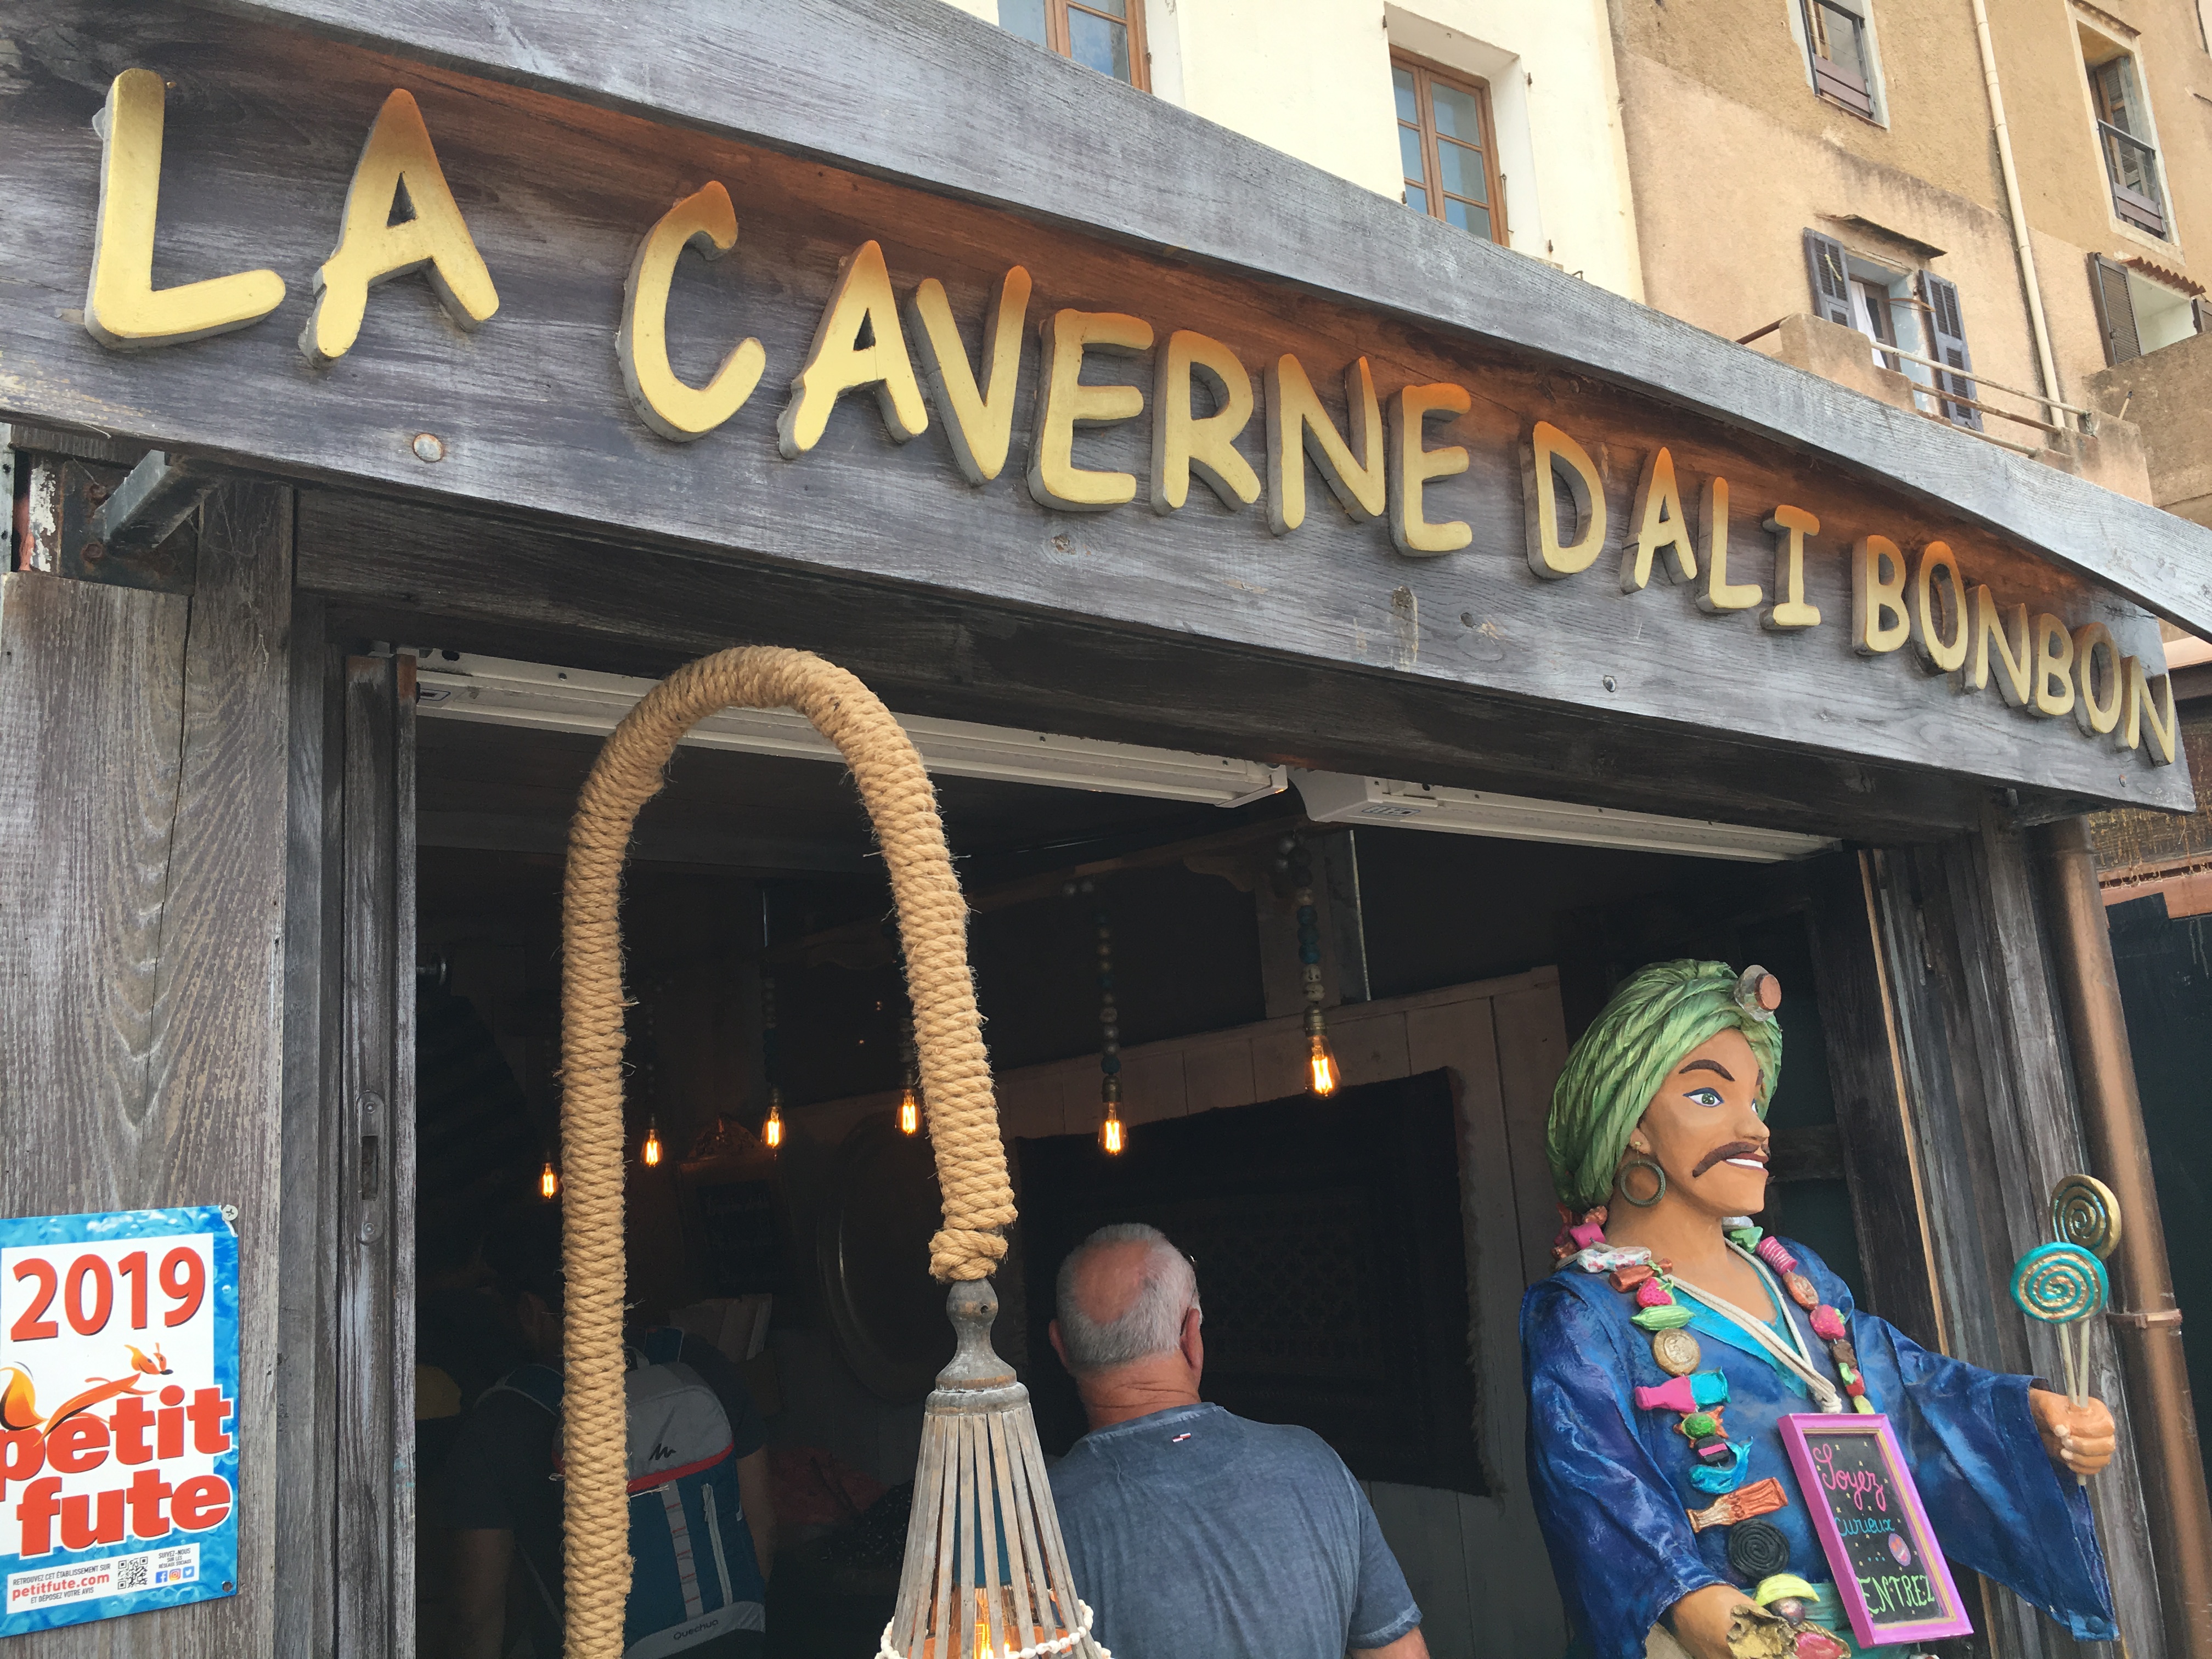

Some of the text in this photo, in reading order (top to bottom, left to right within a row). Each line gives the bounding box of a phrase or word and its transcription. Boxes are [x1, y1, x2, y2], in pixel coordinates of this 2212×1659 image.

[87, 68, 500, 366] LA
[619, 180, 1473, 555] CAVERNE
[1853, 534, 2176, 765] BONBON
[10, 1246, 206, 1342] 2019
[0, 1385, 231, 1502] petit
[1813, 1443, 1886, 1511] Soyez
[16, 1469, 231, 1557] fute
[159, 1548, 191, 1559] SUIVEZ-NOUS
[12, 1574, 110, 1601] petitfute.com
[13, 1576, 44, 1586] RETROUVEZ
[45, 1572, 55, 1582] CET
[56, 1565, 99, 1579] ÉTABLISSEMENT
[38, 1592, 63, 1602] DÉPOSEZ
[64, 1589, 81, 1598] VOTRE
[81, 1587, 94, 1595] AVIS
[1856, 1575, 1935, 1615] ENTREZ
[673, 1620, 719, 1640] Quechua
